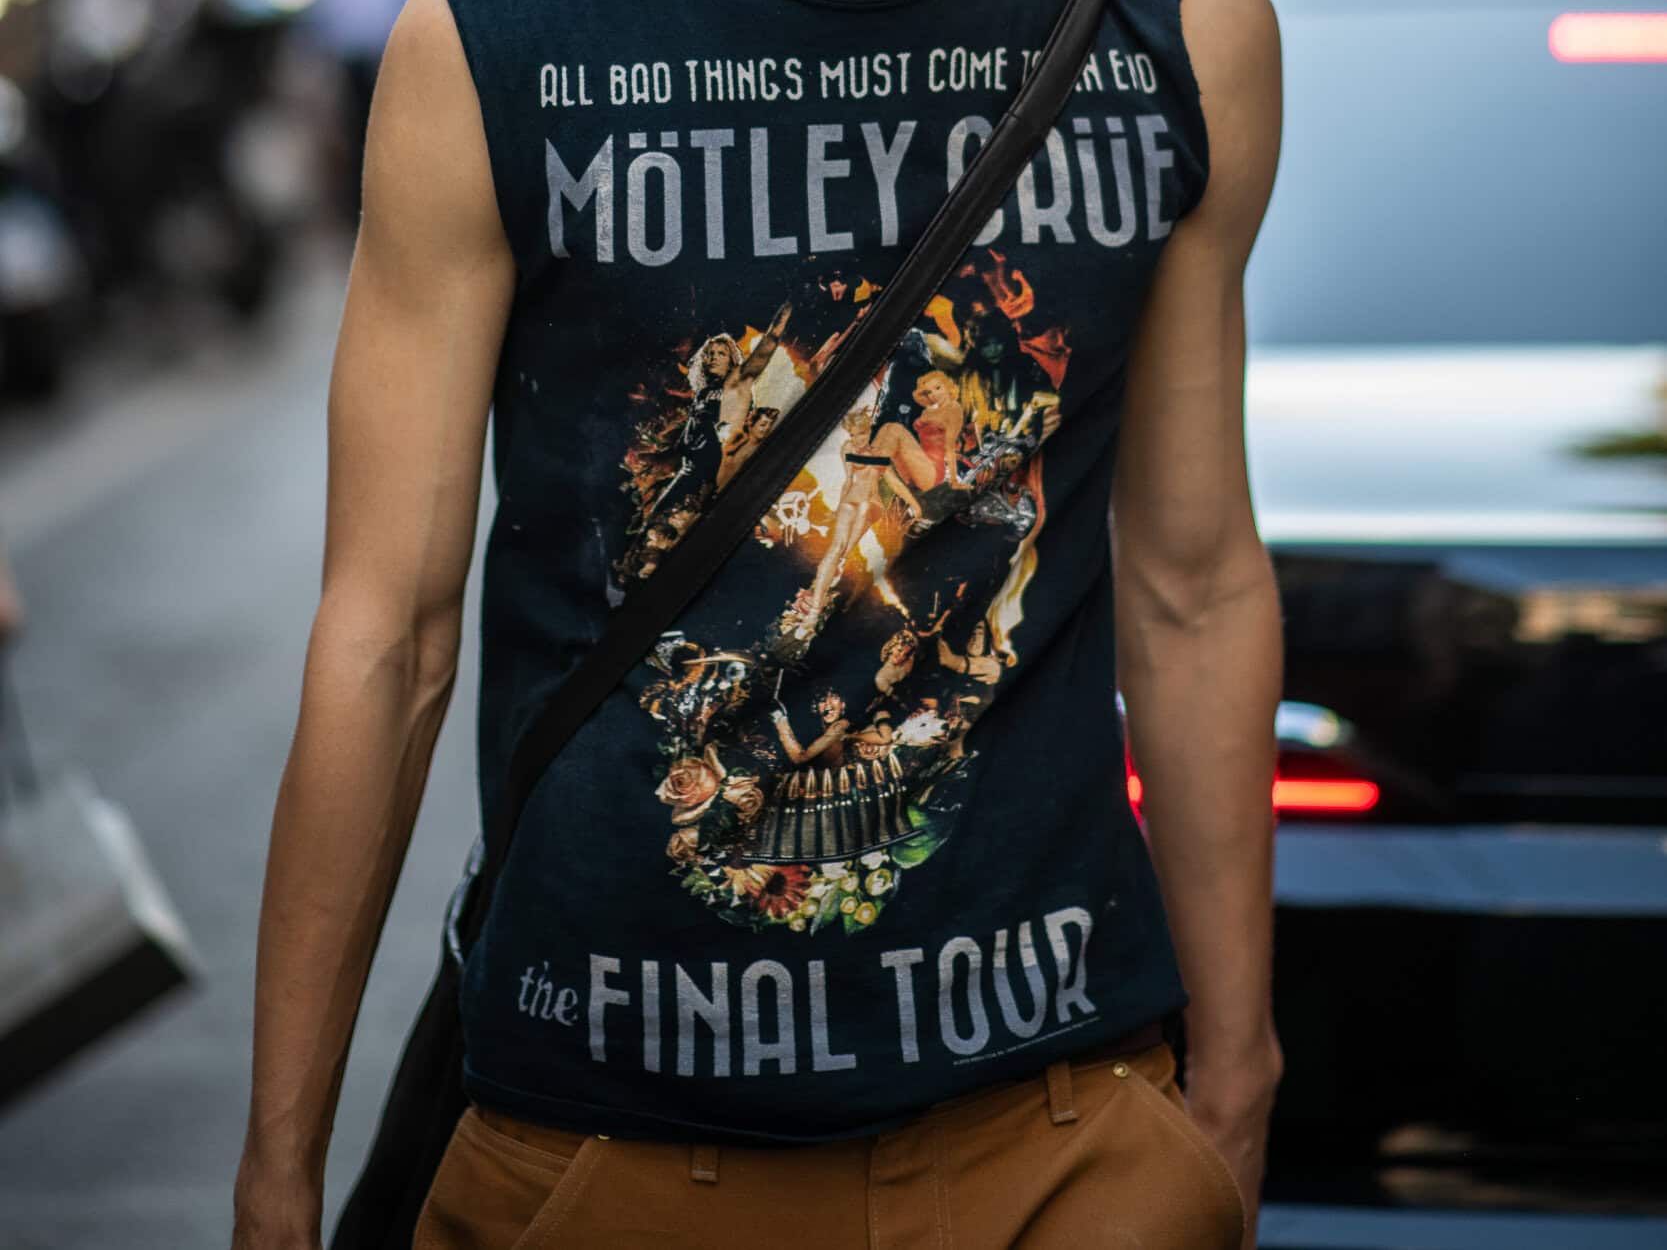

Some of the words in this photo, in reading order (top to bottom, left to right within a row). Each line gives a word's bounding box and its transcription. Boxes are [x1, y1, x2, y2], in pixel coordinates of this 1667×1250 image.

[540, 63, 593, 108] ALL
[609, 61, 672, 106] BAD
[684, 57, 804, 102] THINGS
[820, 52, 912, 99] MUST
[928, 47, 1008, 93] COME
[1021, 50, 1042, 87] T
[1074, 53, 1104, 92] N
[545, 120, 918, 266] MÖTLEY
[518, 960, 579, 1026] the
[588, 953, 857, 1078] FINAL
[880, 906, 1097, 1063] TOUR
